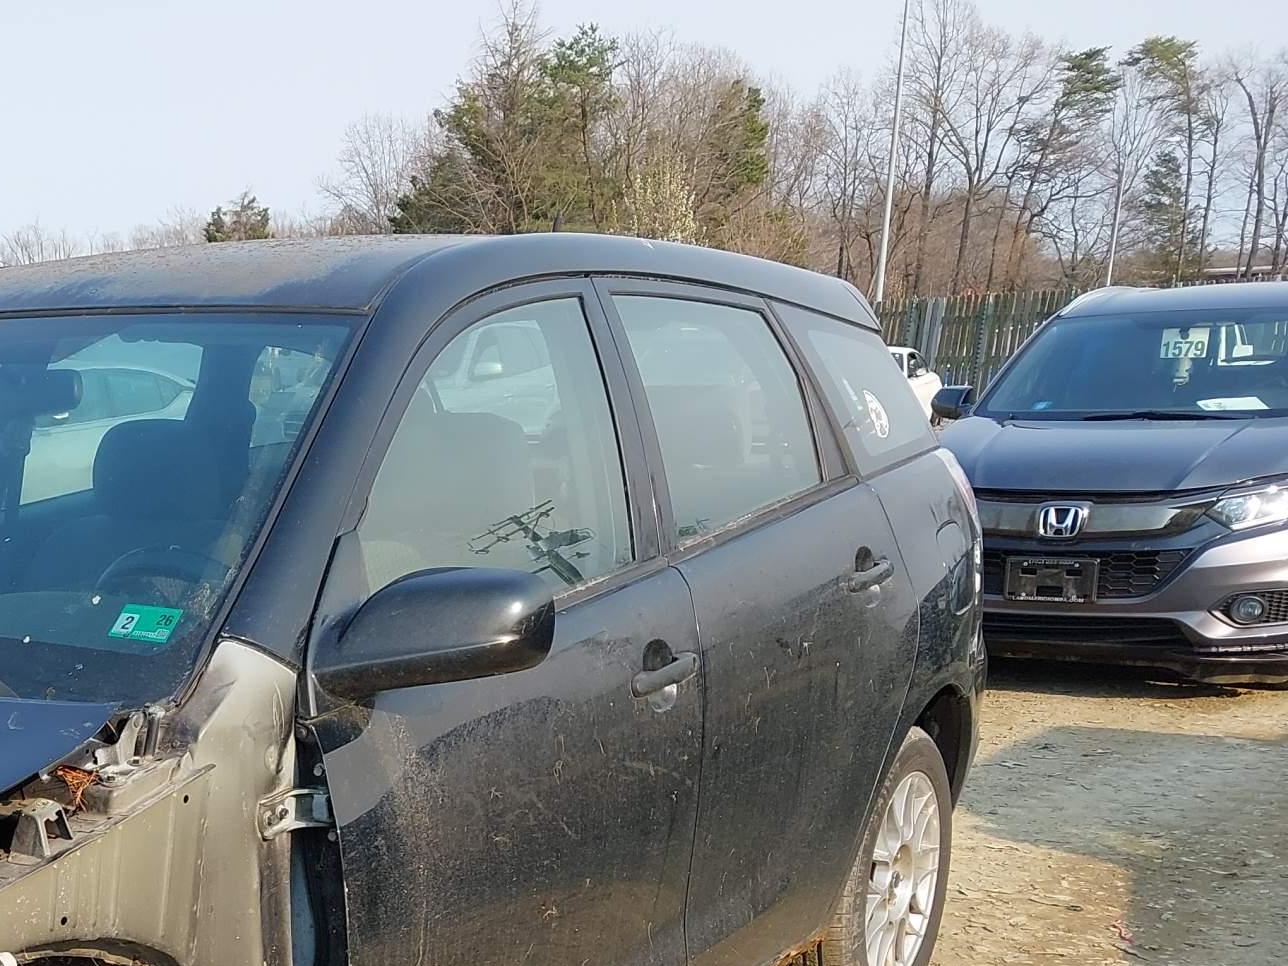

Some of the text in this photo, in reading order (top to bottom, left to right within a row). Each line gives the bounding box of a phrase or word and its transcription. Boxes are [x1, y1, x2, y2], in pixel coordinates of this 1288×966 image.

[1162, 340, 1206, 358] 1579
[120, 614, 175, 630] 2 26
